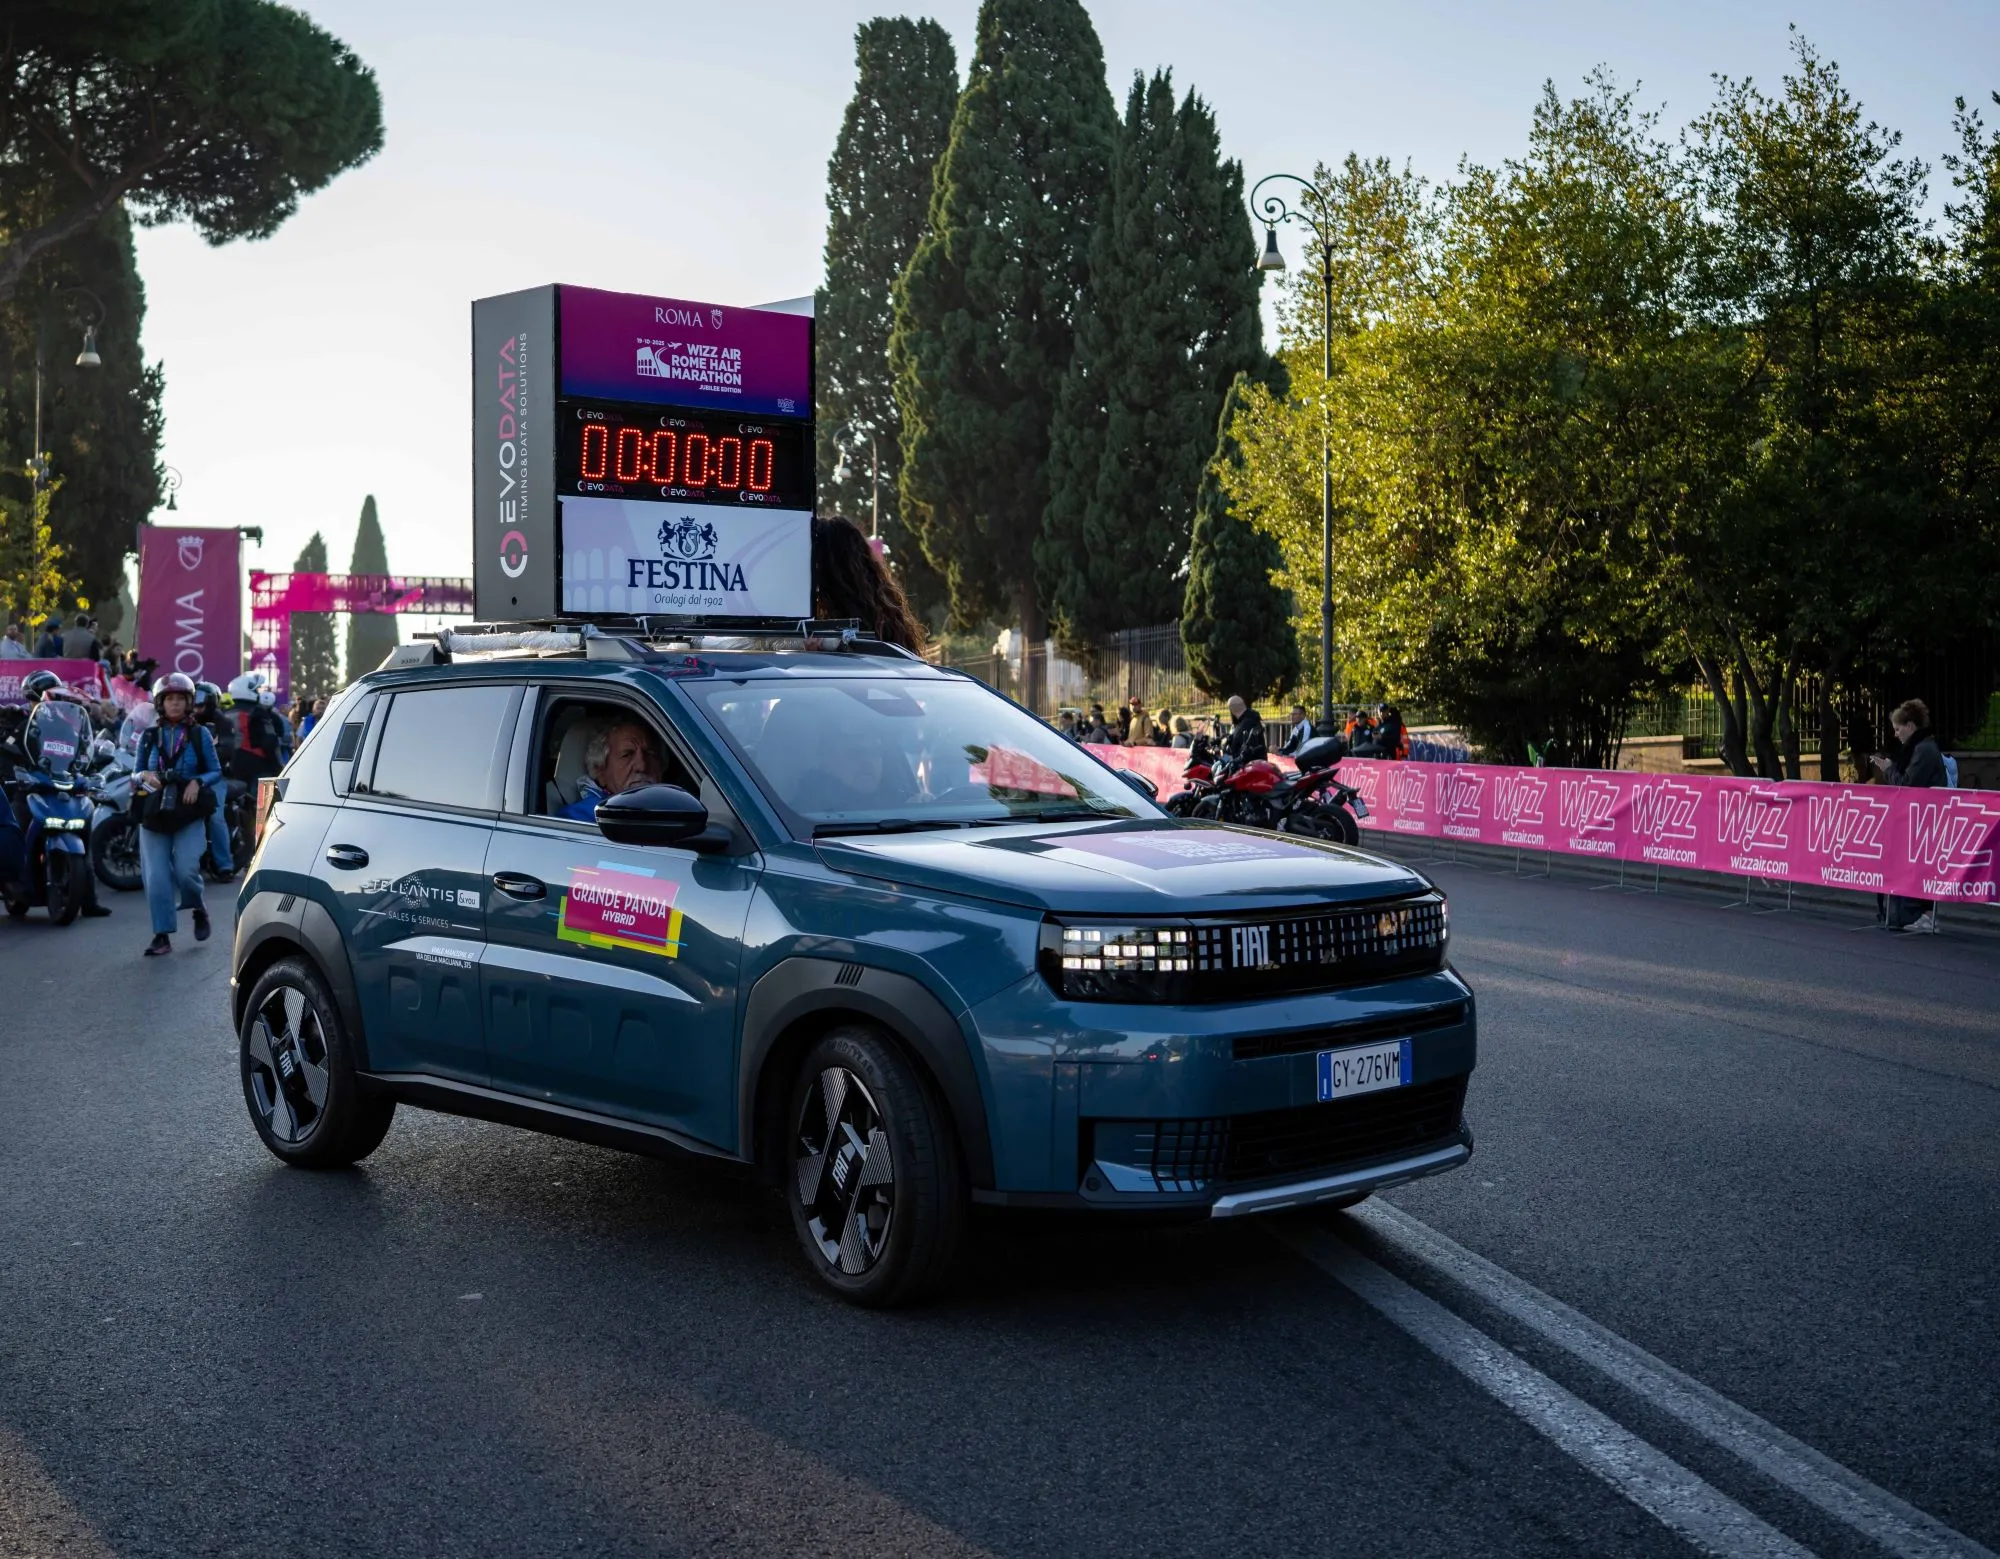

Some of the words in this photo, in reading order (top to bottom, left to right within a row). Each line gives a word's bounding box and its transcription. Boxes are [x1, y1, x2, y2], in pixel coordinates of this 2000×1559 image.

[655, 307, 703, 328] ROMA
[687, 343, 718, 358] WIZZ
[721, 347, 741, 361] AIR
[519, 332, 528, 416] SOLUTIONS
[671, 354, 707, 370] ROME
[709, 358, 741, 373] HALF
[671, 366, 742, 386] MARATHON
[699, 384, 720, 392] JUBILEE
[721, 386, 742, 394] EDITION
[499, 335, 517, 524] EVODATA
[581, 424, 774, 490] 00:00:00
[520, 421, 528, 521] TIMING&DATA
[587, 482, 624, 493] EVODATA
[670, 487, 705, 499] EVODATA
[748, 492, 782, 503] EVODATA
[628, 559, 748, 591] FESTINA
[654, 593, 687, 608] Orologi
[688, 594, 702, 605] dal
[704, 597, 723, 608] 1902
[174, 589, 205, 683] OMA
[1393, 816, 1425, 831] wizzair.com
[1442, 823, 1481, 839] wizzair.com
[1502, 828, 1545, 847] wizzair.com
[1569, 836, 1616, 854] wizzair.com
[1643, 844, 1697, 864] wizzair.com
[1730, 852, 1789, 875] wizzair.com
[1820, 863, 1884, 888] wizzair.com
[1922, 875, 1996, 897] wizzair.com
[361, 879, 455, 902] STELLANTIS
[572, 882, 621, 909] GRANDE
[623, 892, 667, 919] PANDA
[388, 910, 409, 923] SALES
[411, 914, 417, 923] &
[418, 915, 449, 929] SERVICES
[601, 909, 636, 926] HYBRID
[1231, 925, 1270, 968] FIAT
[280, 1050, 294, 1077] FIAT
[1333, 1058, 1350, 1088] GY
[1356, 1050, 1400, 1085] 276VM
[832, 1150, 849, 1190] FIAT
